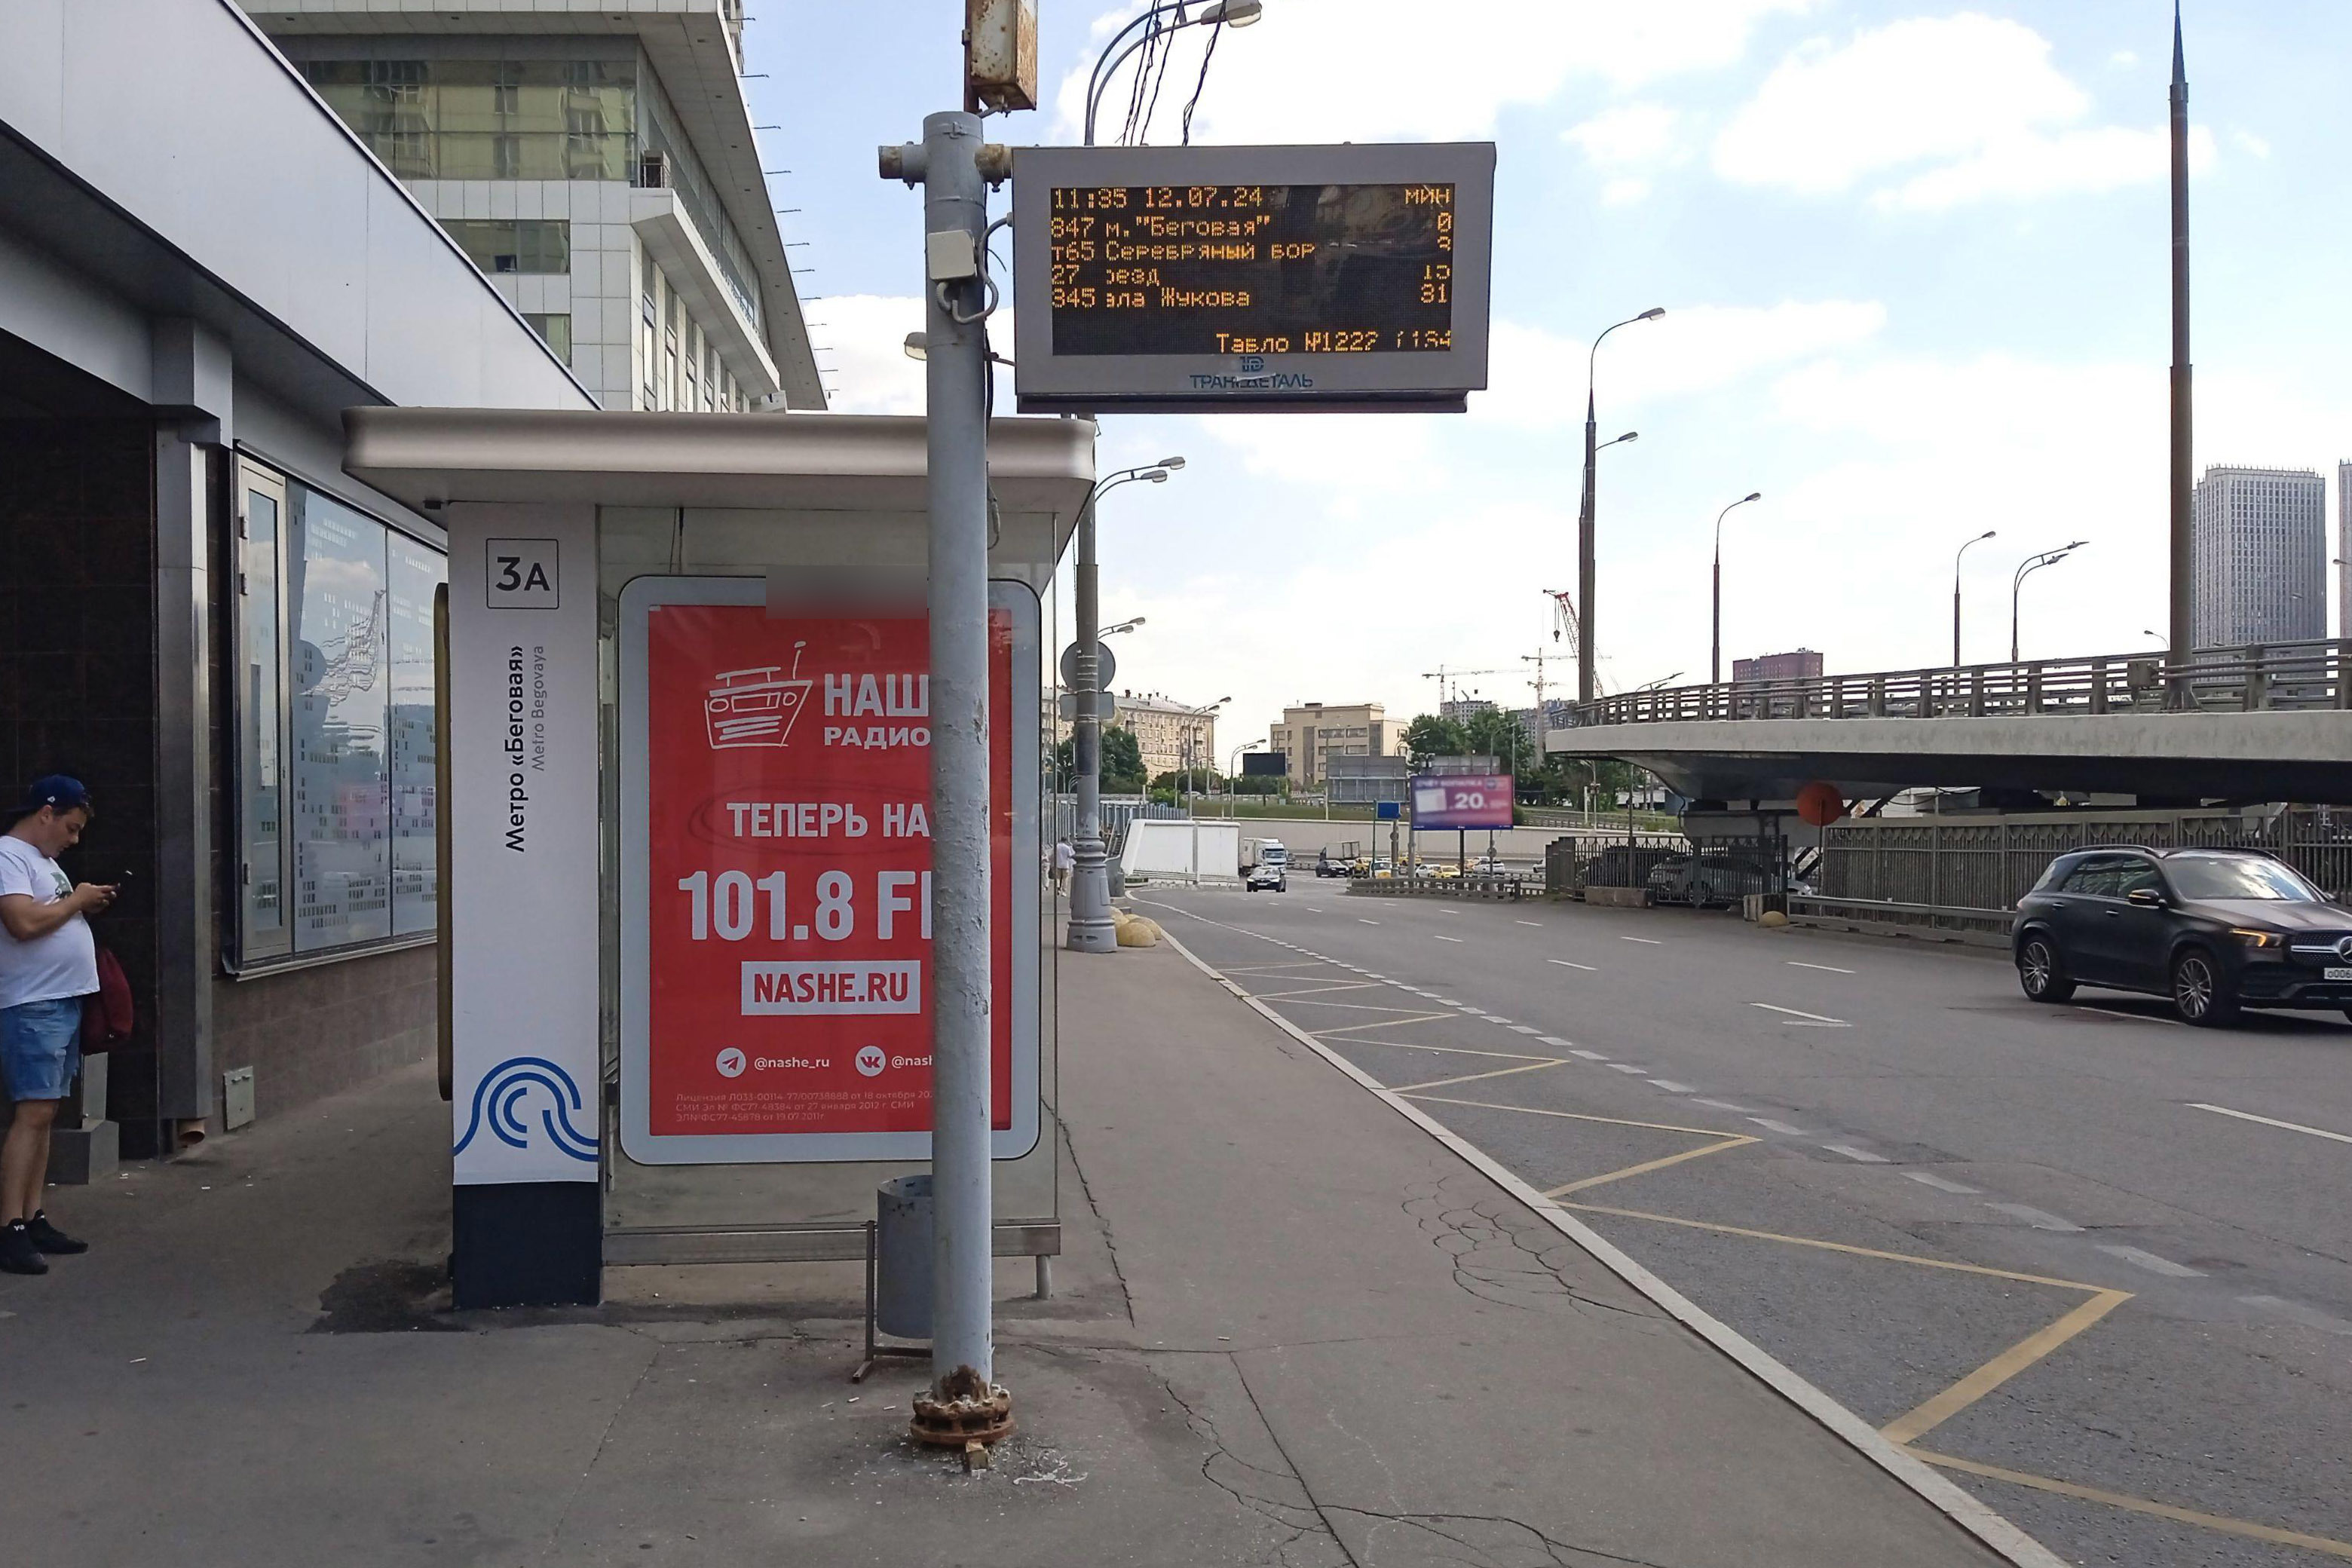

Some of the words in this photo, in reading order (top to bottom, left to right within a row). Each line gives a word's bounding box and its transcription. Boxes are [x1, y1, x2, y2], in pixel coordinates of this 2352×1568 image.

[1055, 188, 1128, 209] 11:35
[1145, 187, 1263, 209] 12.07.24
[1051, 264, 1080, 286] 27
[1161, 287, 1251, 308] Жукова
[531, 645, 548, 719] Begovaya
[504, 645, 525, 767] «Беговая»
[531, 721, 545, 772] Metro
[823, 726, 931, 750] РАДИО
[505, 772, 528, 853] Метро
[726, 802, 868, 838] ТЕПЕРЬ
[883, 803, 930, 838] НА
[678, 870, 855, 942] 101.8
[753, 972, 909, 1003] NASHE.RU
[754, 1057, 830, 1071] @nashe_ru
[675, 1103, 700, 1112] СМИ
[858, 1101, 880, 1110] 2012
[890, 1101, 914, 1109] СМИ
[875, 1091, 916, 1101] октября
